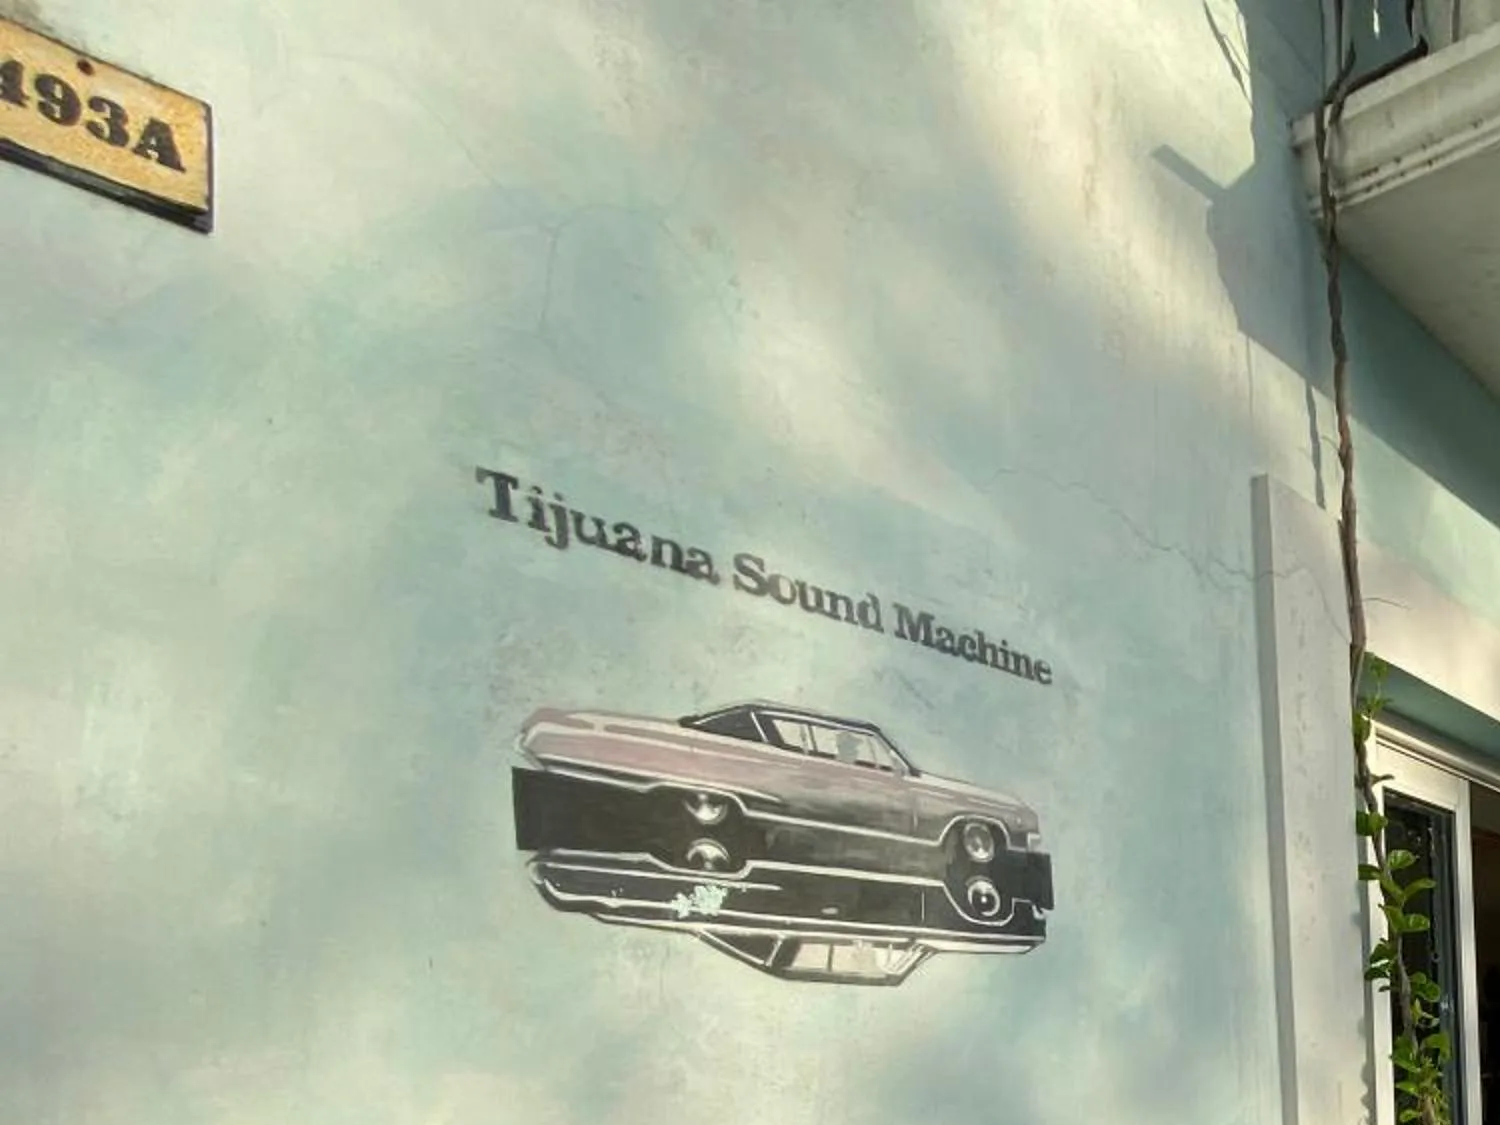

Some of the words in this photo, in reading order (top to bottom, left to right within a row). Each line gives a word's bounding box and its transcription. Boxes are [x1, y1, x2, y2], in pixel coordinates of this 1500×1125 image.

[476, 465, 720, 586] Tijuana
[733, 552, 886, 634] Sound
[894, 602, 1053, 685] Machine
